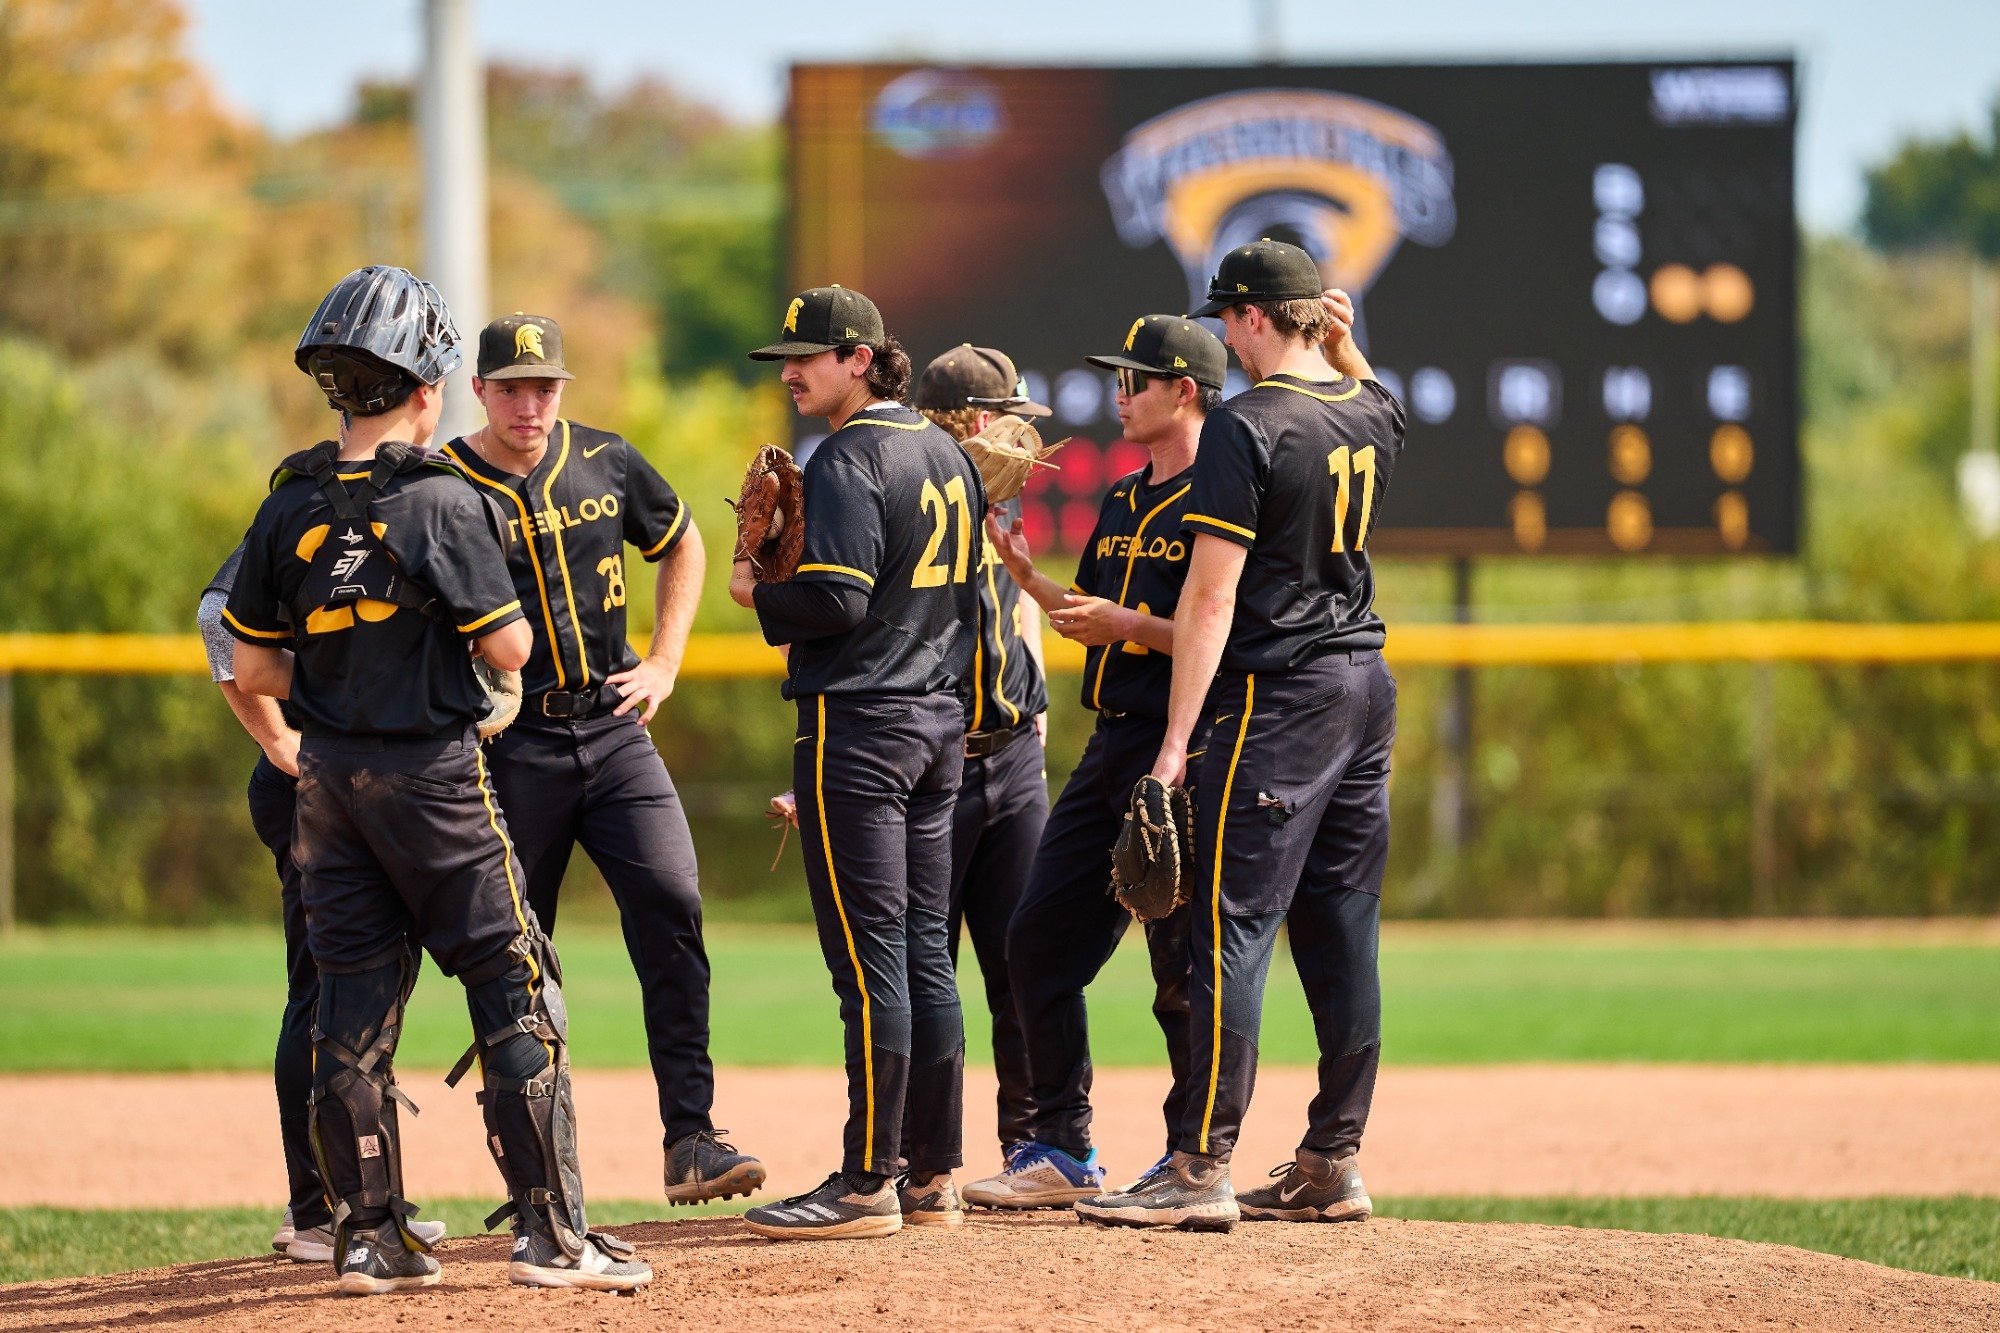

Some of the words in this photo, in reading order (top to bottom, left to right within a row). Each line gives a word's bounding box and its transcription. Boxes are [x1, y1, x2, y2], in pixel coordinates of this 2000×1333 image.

[508, 493, 619, 542] TERLOO
[1327, 445, 1376, 553] 11
[910, 475, 971, 589] 21
[1096, 535, 1186, 562] WATERLOO
[596, 553, 626, 613] 28
